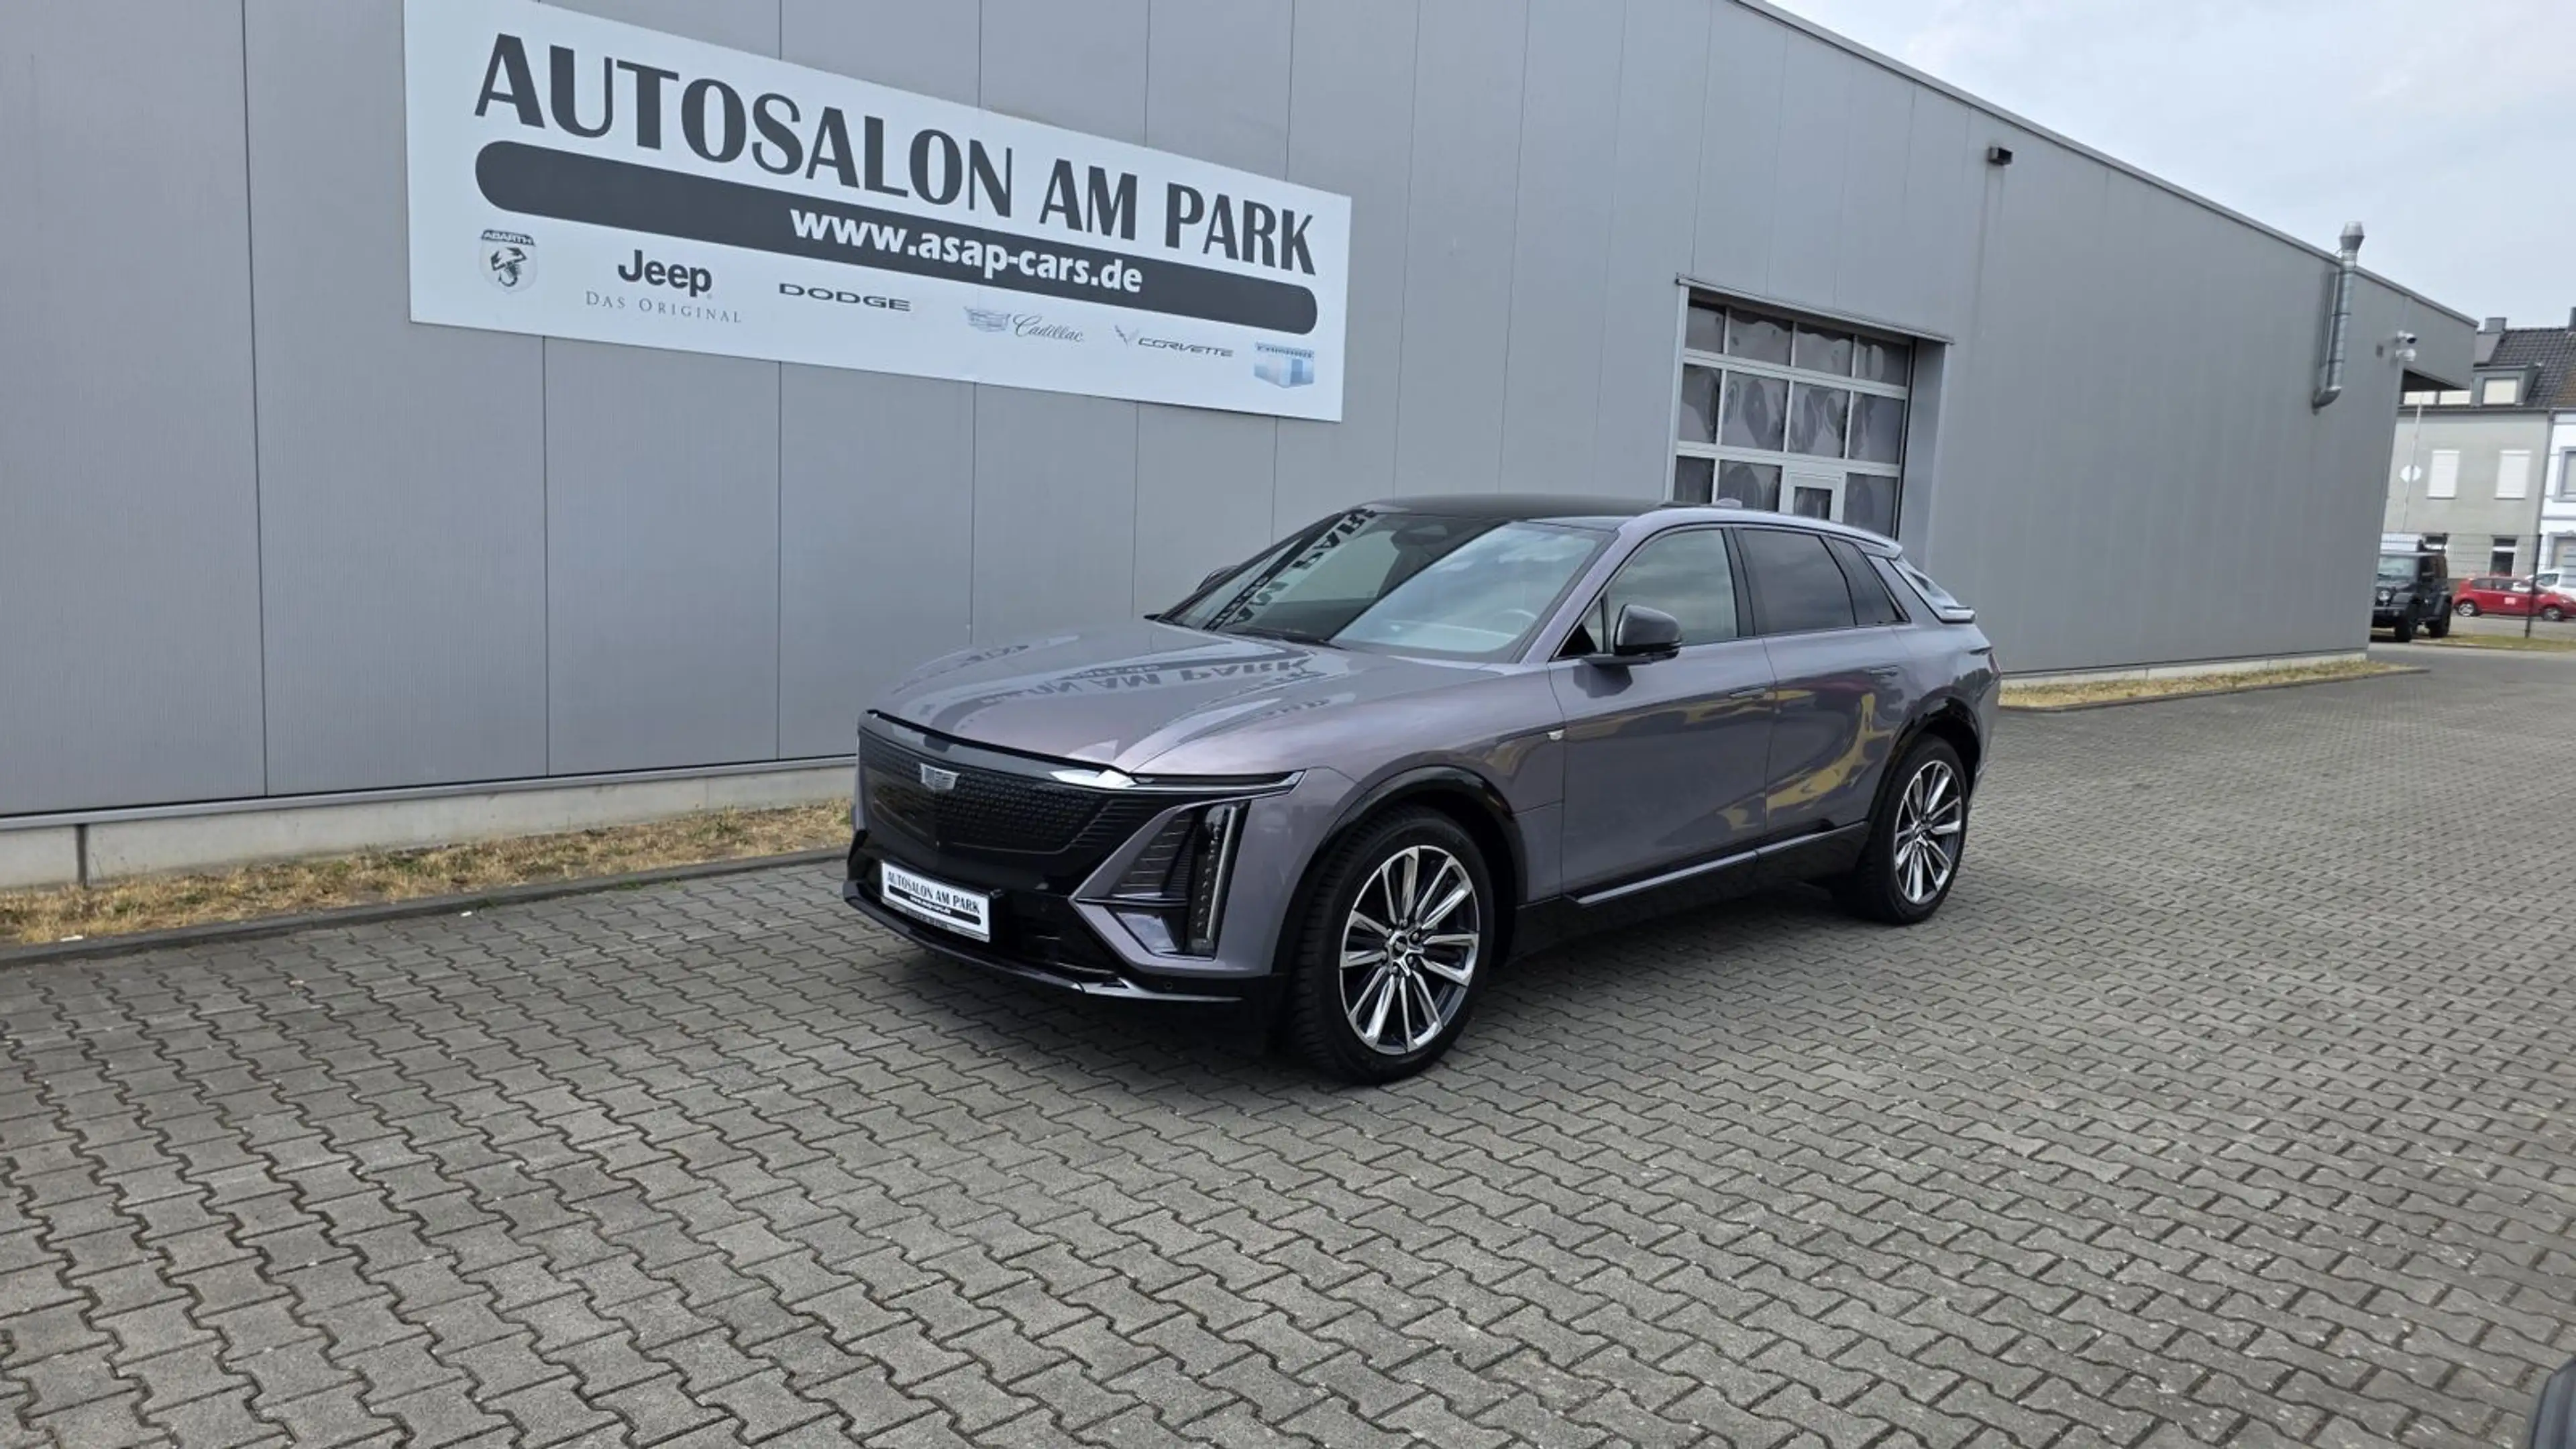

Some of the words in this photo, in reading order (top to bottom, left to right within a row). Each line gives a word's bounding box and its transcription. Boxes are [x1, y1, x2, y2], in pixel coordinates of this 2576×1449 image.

[475, 34, 1013, 219] AUTOSALON
[1039, 158, 1138, 240] AM
[1165, 182, 1316, 276] PARK
[482, 229, 534, 246] ABARTH
[790, 209, 1142, 292] www.asap-cars.de
[618, 249, 712, 297] Jeep
[778, 282, 911, 311] DODGE
[1012, 313, 1084, 342] Cadillac
[1138, 337, 1234, 358] CORVETTE
[888, 871, 933, 900] AUTOSALON
[935, 890, 950, 905] AM
[953, 895, 980, 914] PARK
